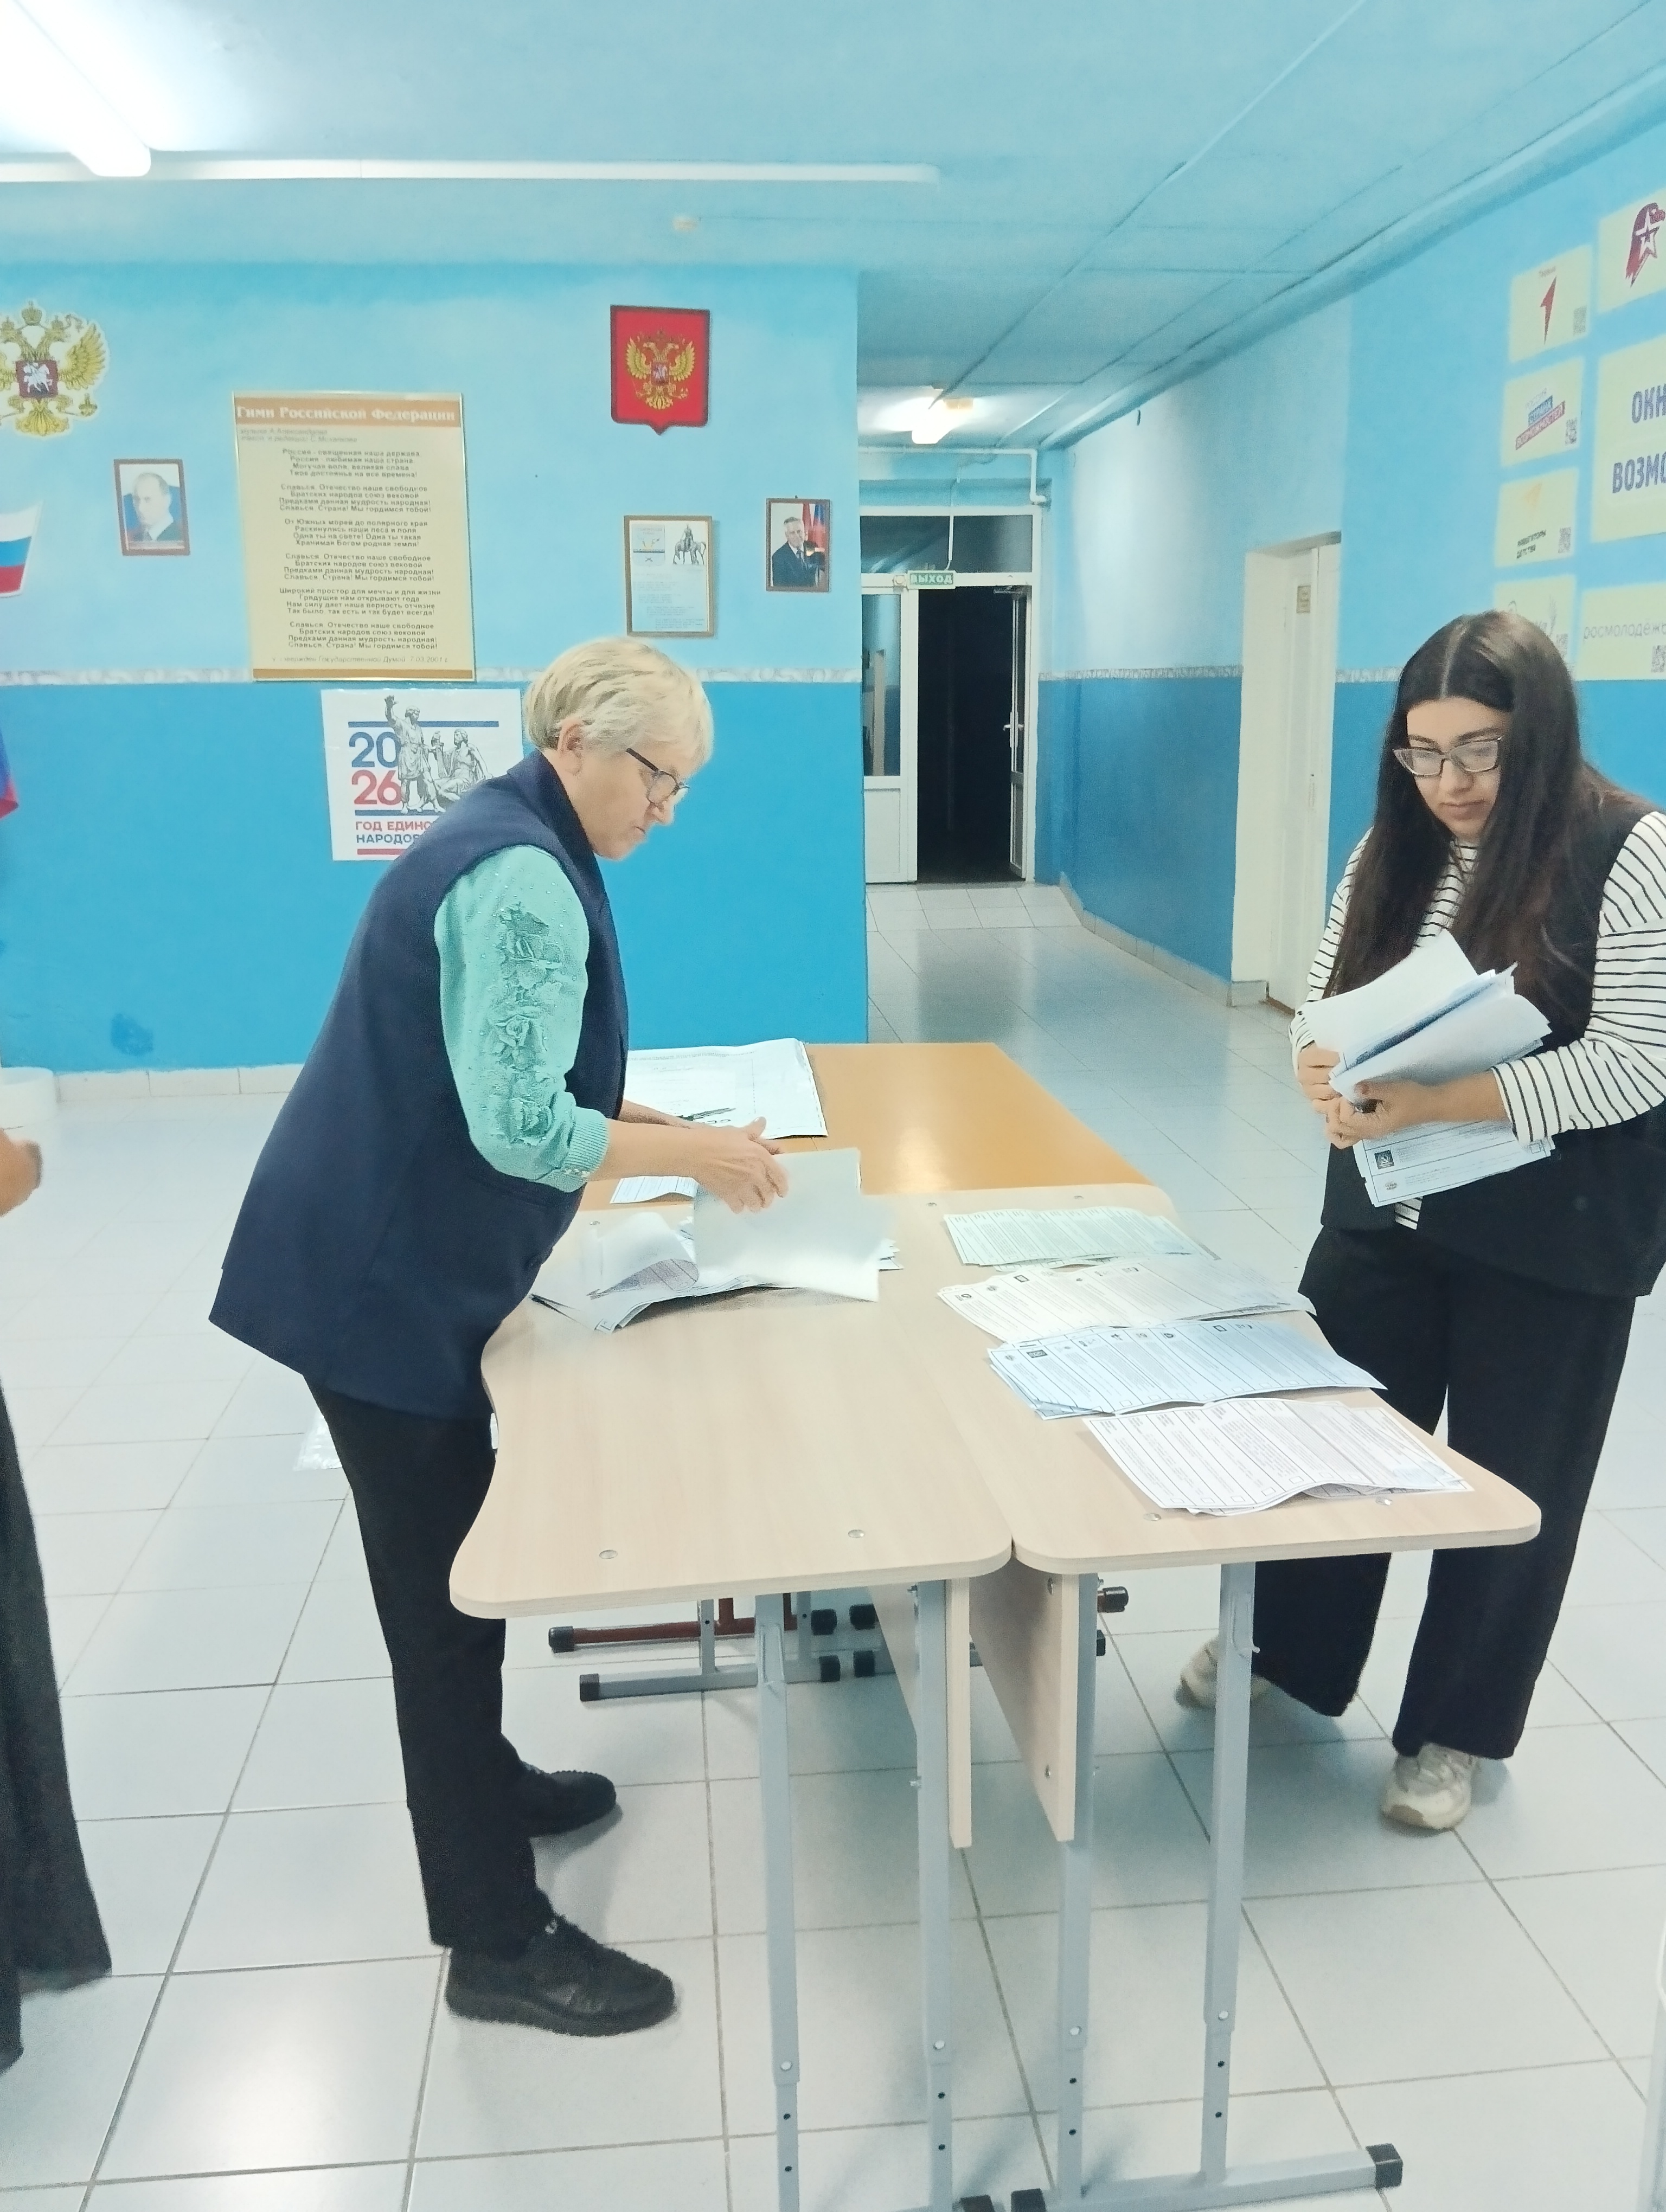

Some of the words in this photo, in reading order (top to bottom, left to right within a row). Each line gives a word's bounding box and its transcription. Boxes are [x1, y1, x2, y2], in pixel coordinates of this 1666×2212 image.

[237, 407, 274, 419] Гимн
[280, 407, 367, 420] Российской
[371, 409, 456, 423] Федерации
[910, 574, 953, 584] ВЫХОД
[349, 732, 401, 768] 20
[351, 769, 402, 806] 26
[355, 821, 383, 832] ГОД
